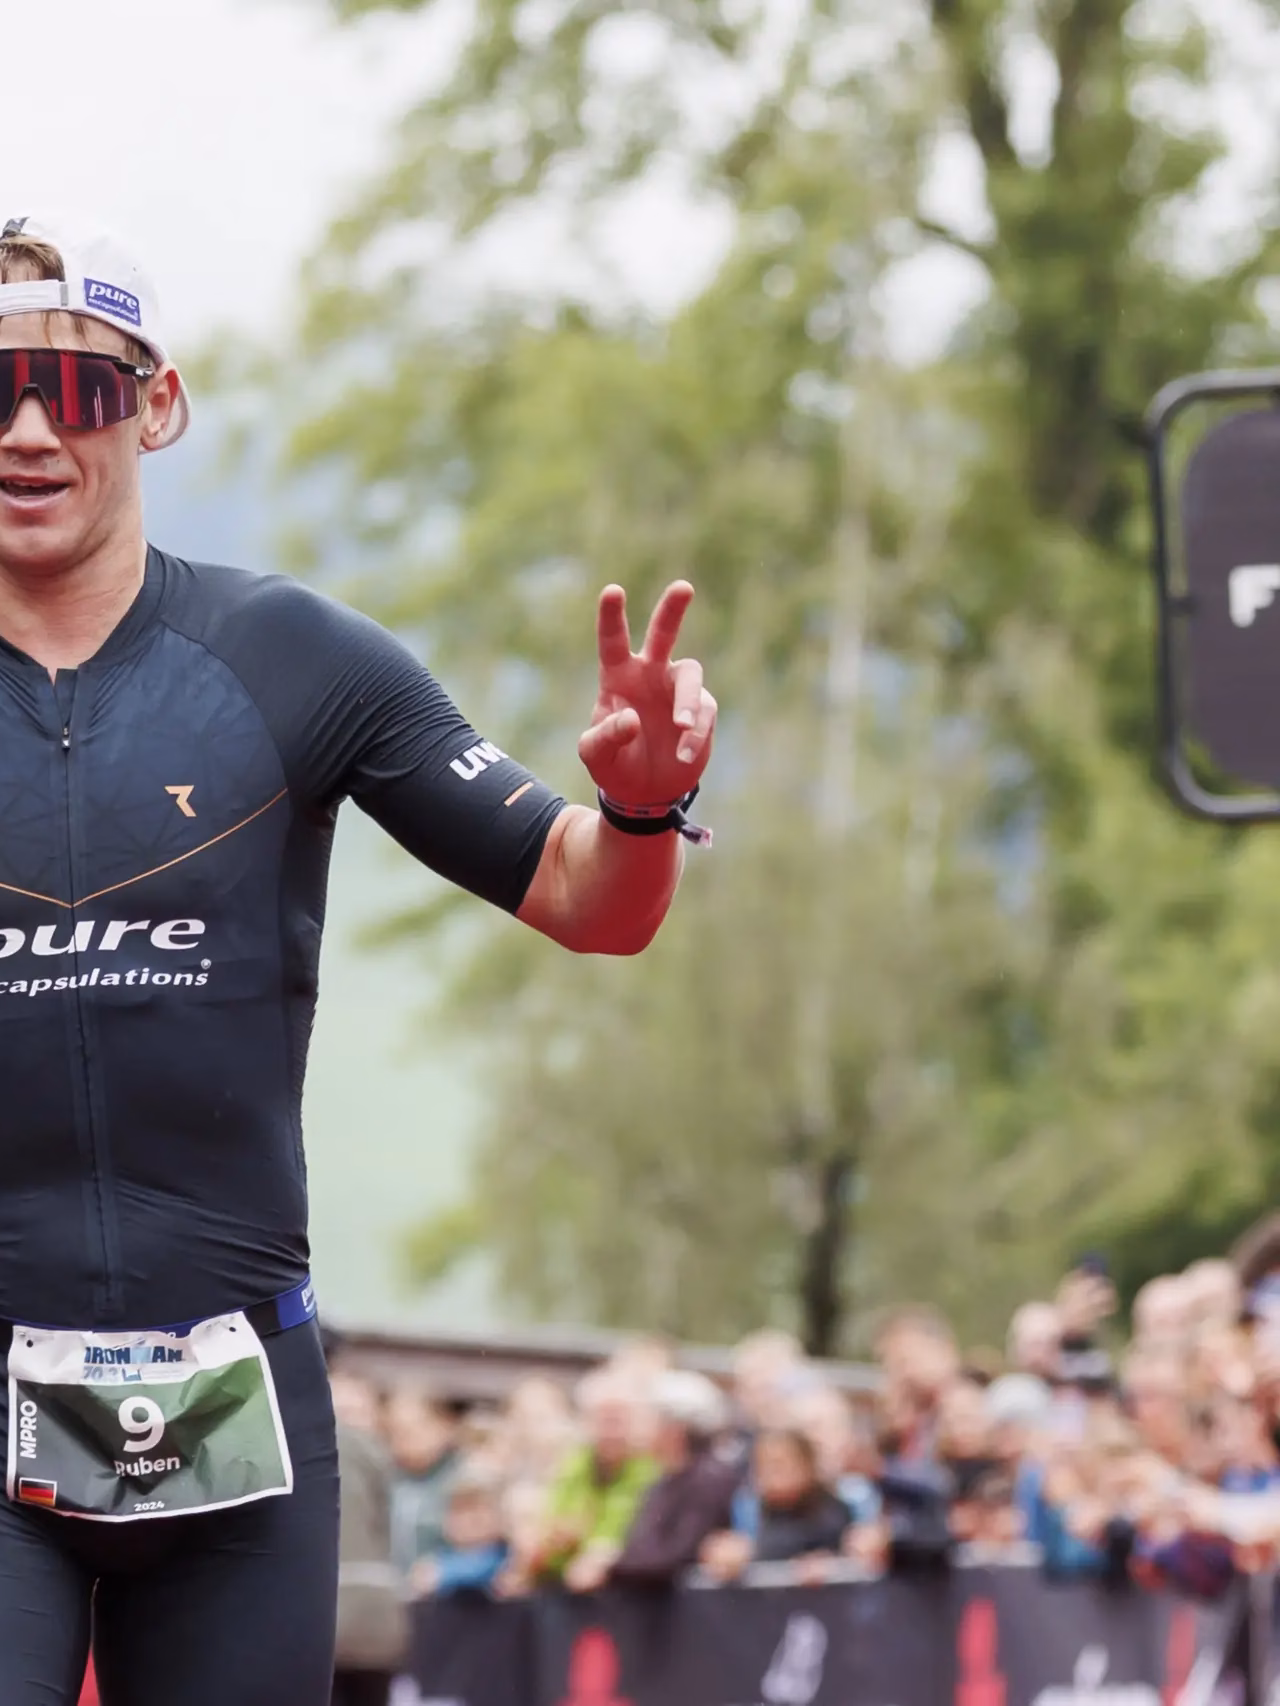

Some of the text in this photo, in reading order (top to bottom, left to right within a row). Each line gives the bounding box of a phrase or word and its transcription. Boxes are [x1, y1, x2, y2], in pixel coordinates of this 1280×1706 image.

[89, 283, 138, 310] pure
[19, 1400, 37, 1459] MPRO
[118, 1396, 165, 1453] 9
[114, 1456, 180, 1477] Ruben
[133, 1501, 165, 1512] 2024
